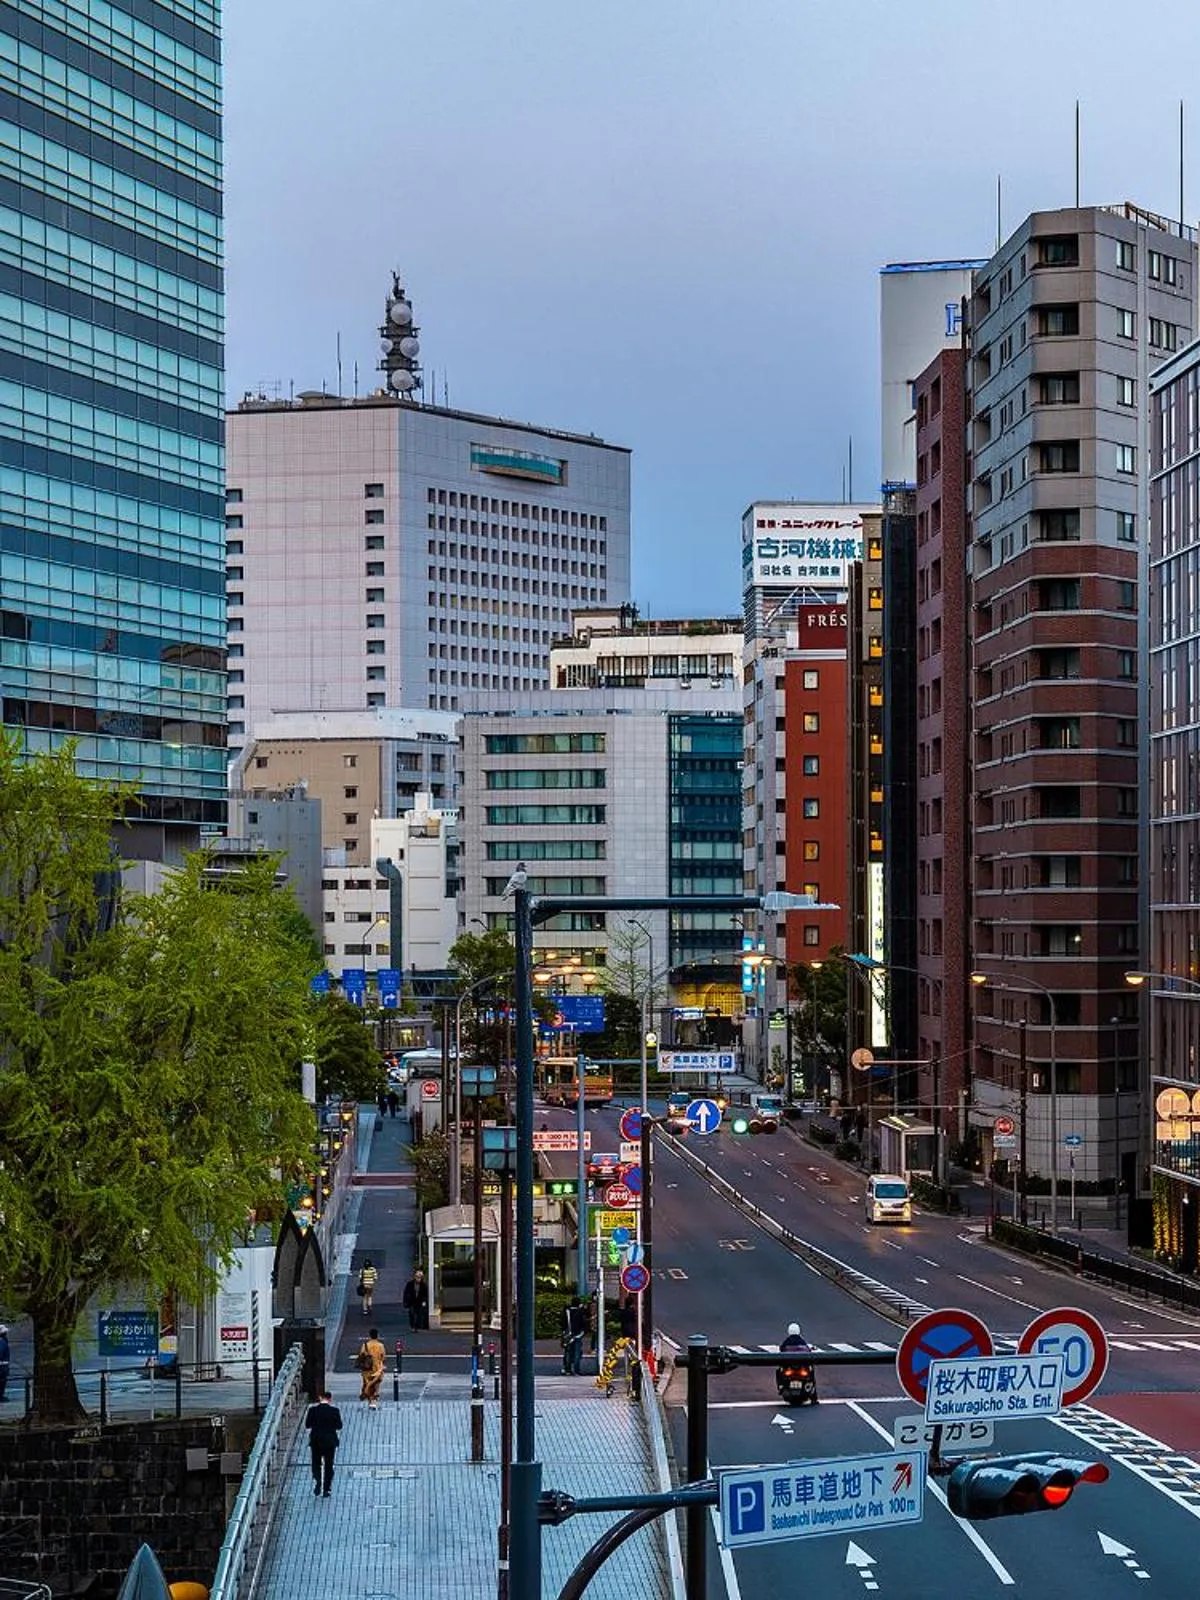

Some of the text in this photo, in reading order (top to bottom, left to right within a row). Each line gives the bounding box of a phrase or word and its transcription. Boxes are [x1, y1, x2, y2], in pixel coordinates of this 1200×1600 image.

[756, 537, 864, 559] 古河機械
[934, 1363, 1058, 1396] 桜木町駅入口
[934, 1393, 1054, 1415] Sakuragicho Sta. Ent.
[771, 1466, 885, 1508] 馬車道地下
[736, 1487, 757, 1531] P
[854, 1503, 867, 1517] Car
[868, 1501, 884, 1516] Park
